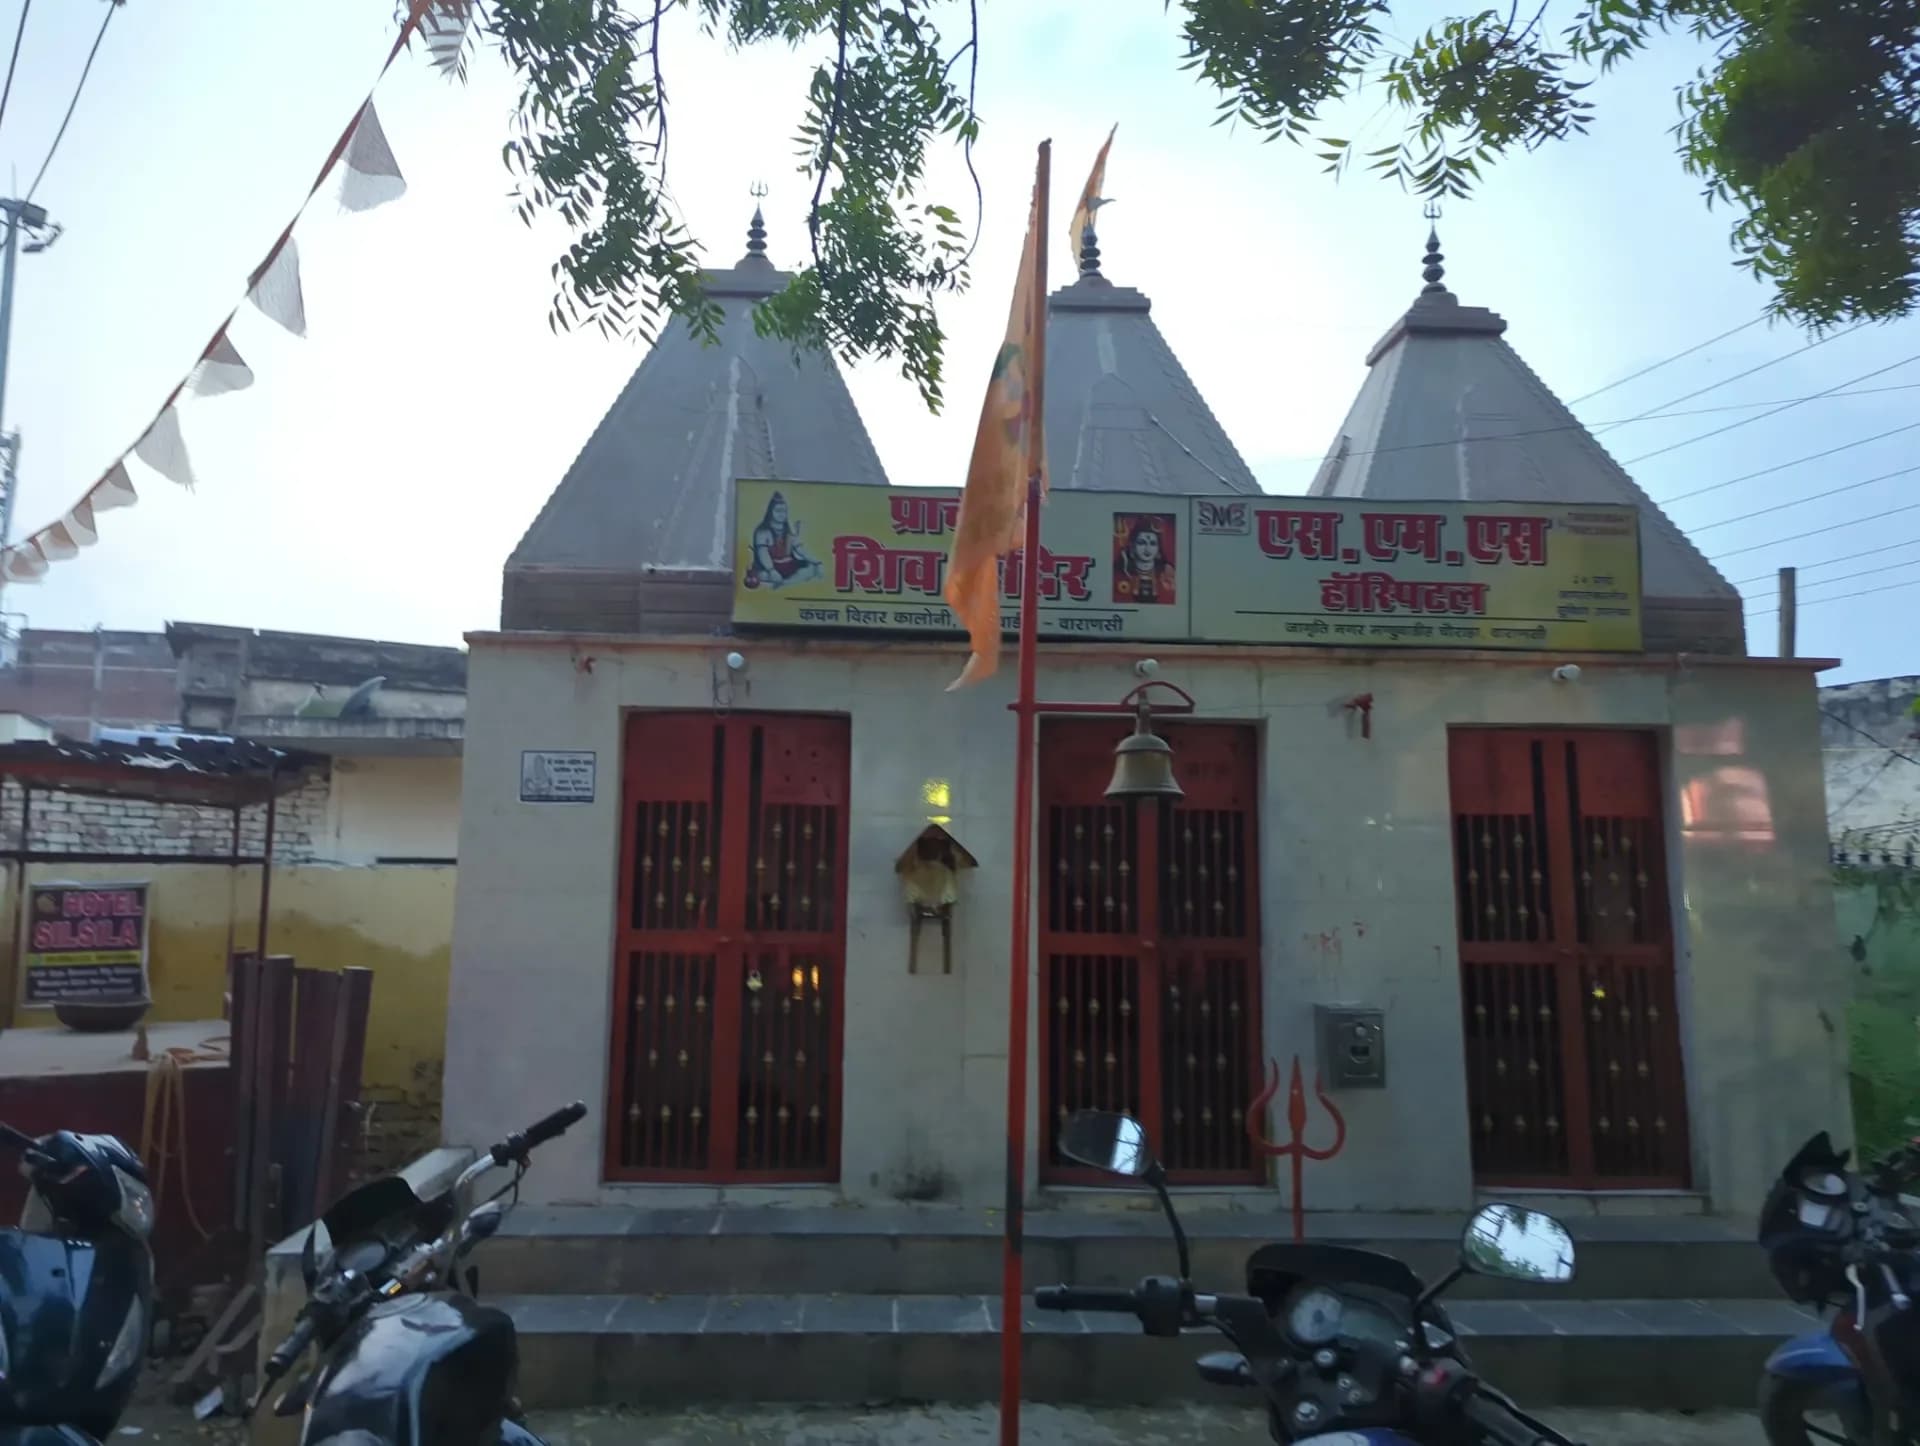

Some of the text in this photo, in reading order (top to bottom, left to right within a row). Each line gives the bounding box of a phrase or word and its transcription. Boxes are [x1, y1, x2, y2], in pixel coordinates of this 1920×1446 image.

[832, 535, 948, 597] शिव
[845, 604, 888, 625] विहार
[1058, 613, 1123, 632] वाराणसी
[62, 891, 143, 918] HOTEL
